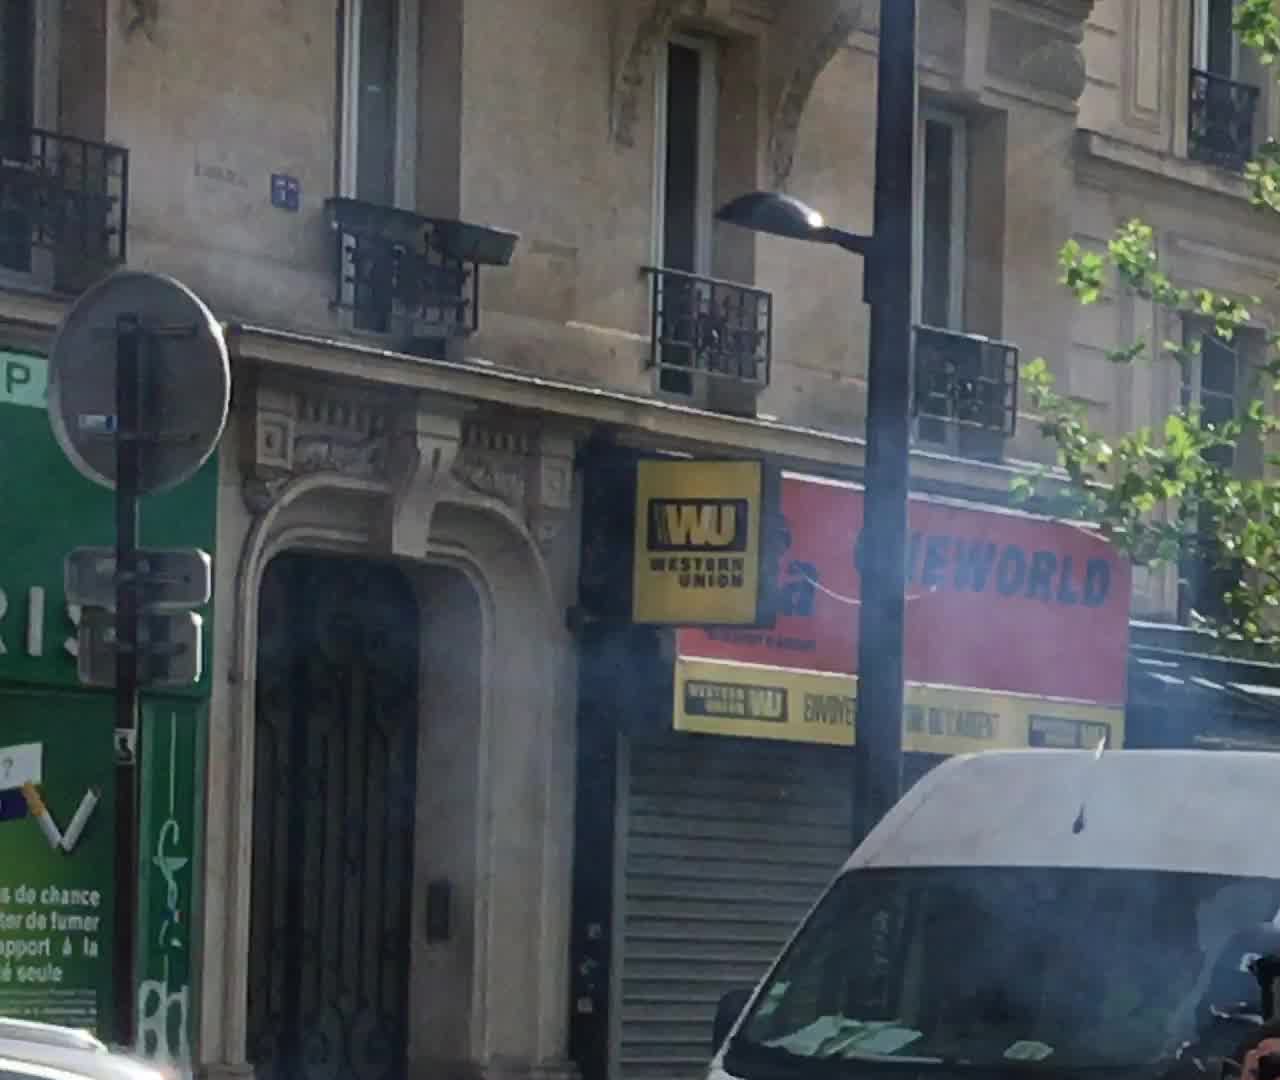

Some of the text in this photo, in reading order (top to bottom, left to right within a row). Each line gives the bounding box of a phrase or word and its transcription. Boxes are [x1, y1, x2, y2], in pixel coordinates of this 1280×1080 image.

[649, 556, 744, 572] WESTERN
[678, 573, 744, 589] UNION
[15, 885, 36, 905] de
[40, 885, 101, 907] chance
[25, 911, 47, 930] de
[51, 911, 100, 931] fumer
[83, 935, 98, 958] la
[17, 963, 63, 983] seule
